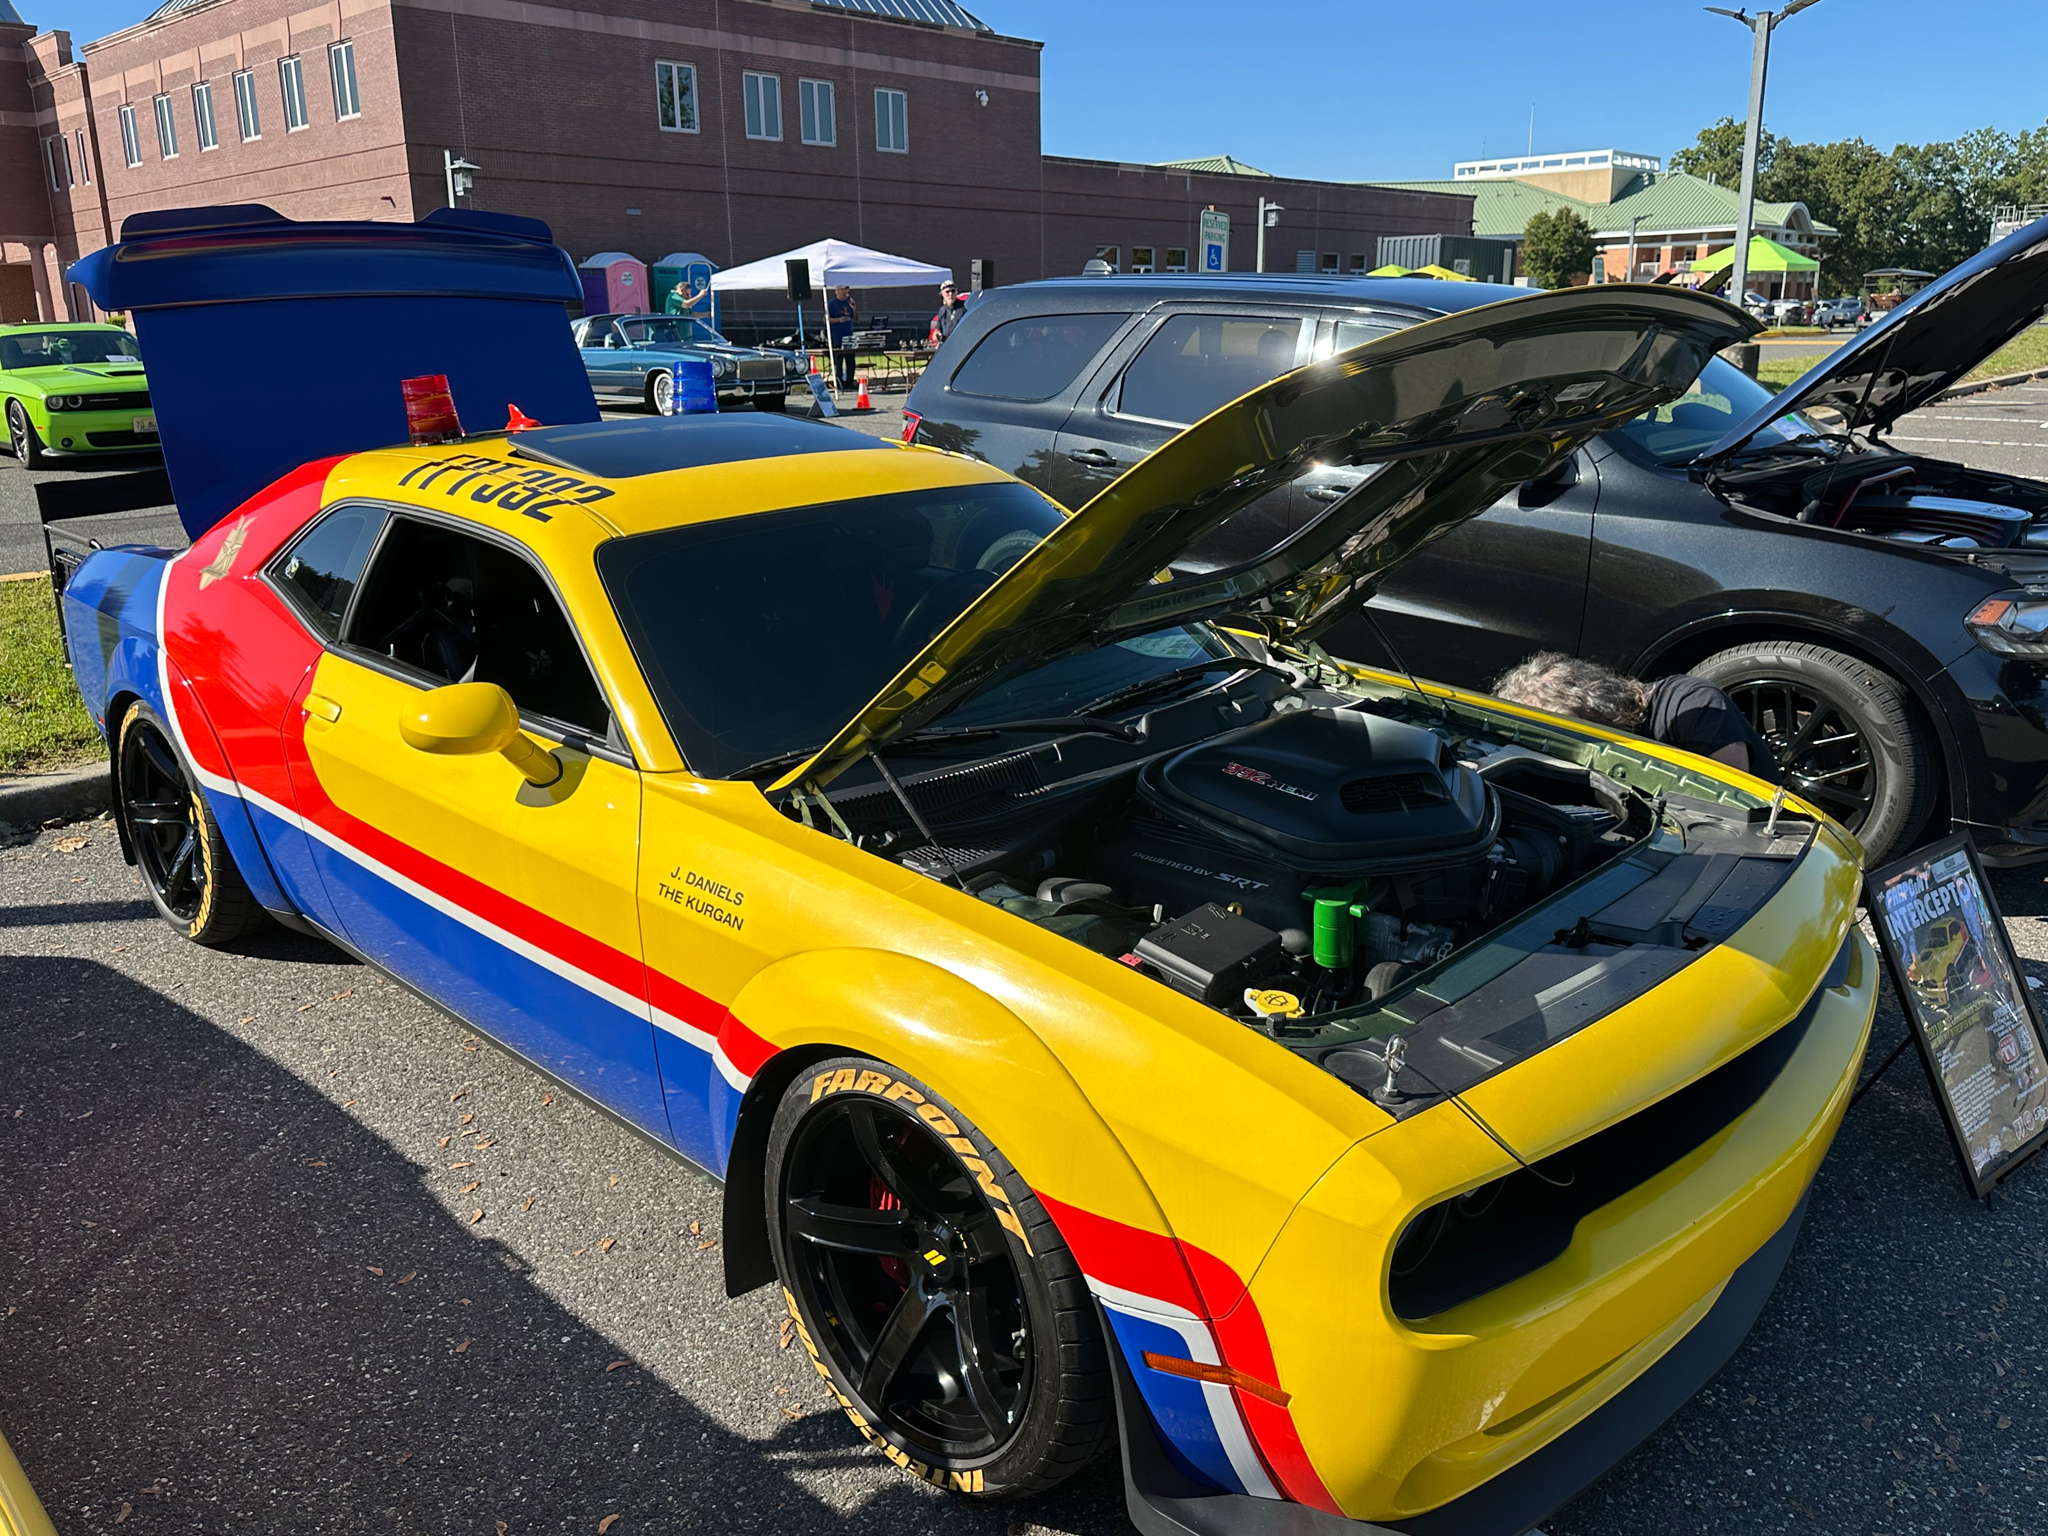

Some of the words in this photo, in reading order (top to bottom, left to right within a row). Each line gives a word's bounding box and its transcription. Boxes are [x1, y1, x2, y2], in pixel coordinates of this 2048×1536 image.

[1203, 219, 1227, 231] RESERVED
[1205, 231, 1225, 243] PARKING
[398, 454, 616, 523] FPT392
[1138, 588, 1206, 613] SHAKER
[1222, 762, 1272, 785] 392
[1266, 781, 1318, 801] HEMI
[1870, 794, 1898, 850] 265/50
[670, 866, 681, 881] J.
[685, 871, 744, 906] DANIELS
[1133, 851, 1194, 874] POWERED
[1193, 866, 1213, 877] BY
[1213, 872, 1270, 890] SRT
[659, 882, 684, 905] THE
[685, 895, 744, 931] KURGAN
[1884, 873, 1979, 940] INTERCEPTOR
[2001, 1043, 2016, 1061] TV
[809, 1067, 1035, 1258] FARPOINT
[782, 1285, 985, 1494] INTERCEPTOR
